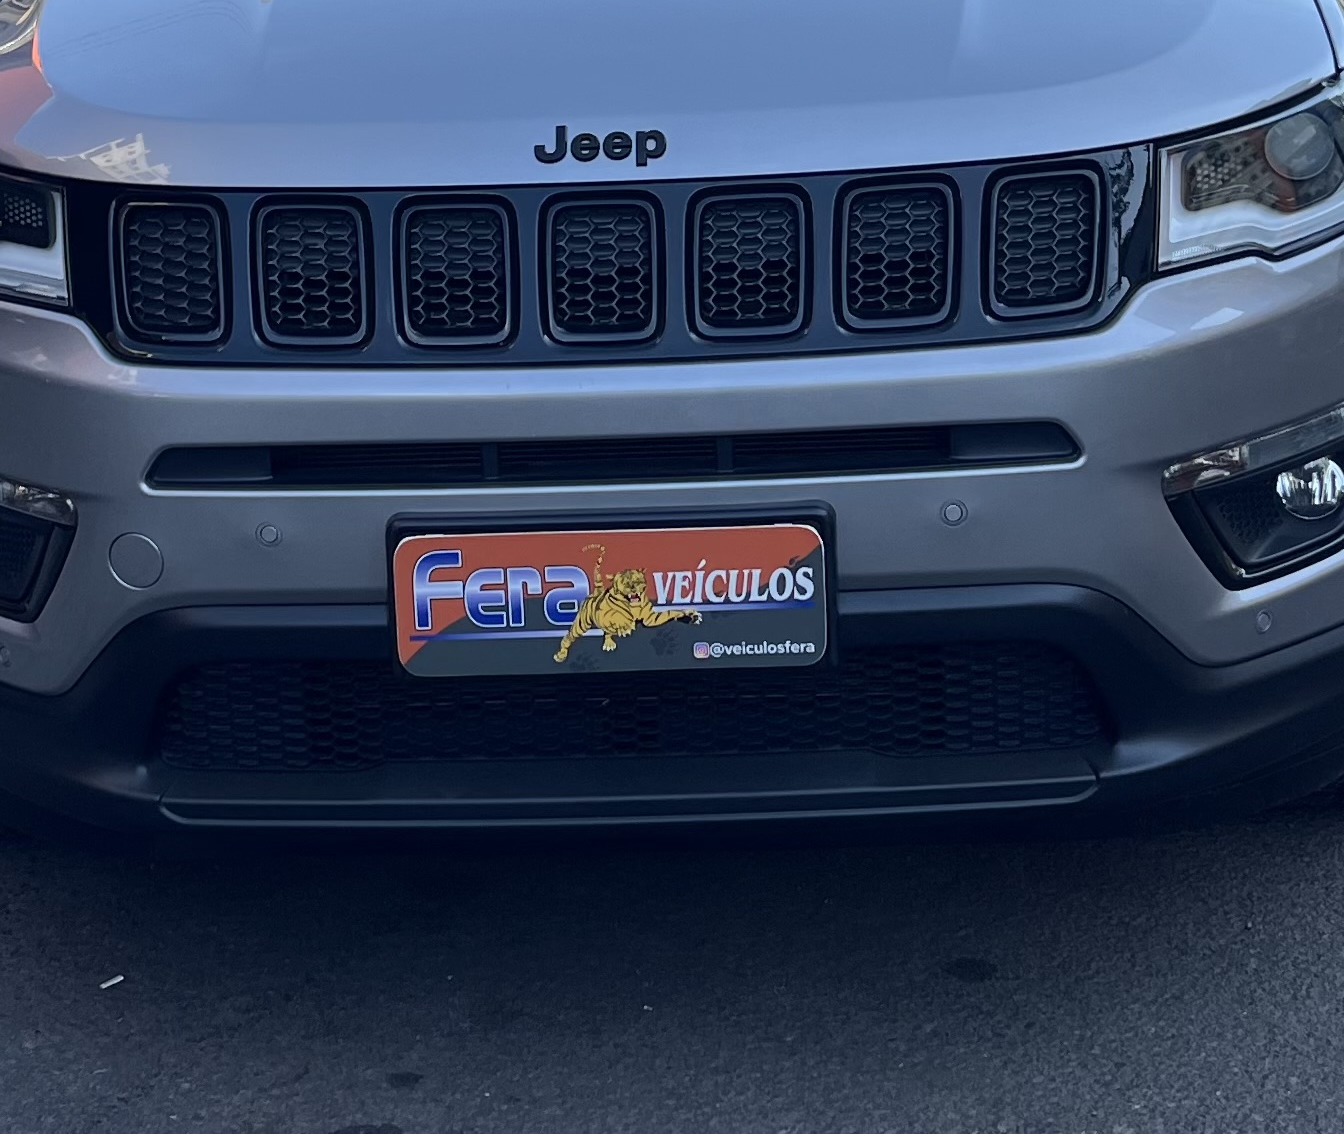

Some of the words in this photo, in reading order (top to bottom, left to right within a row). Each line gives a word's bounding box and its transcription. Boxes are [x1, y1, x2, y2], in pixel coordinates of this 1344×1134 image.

[534, 124, 667, 167] Jeep
[652, 558, 815, 605] VEÍCULOS
[710, 640, 816, 658] @veiculosfera
